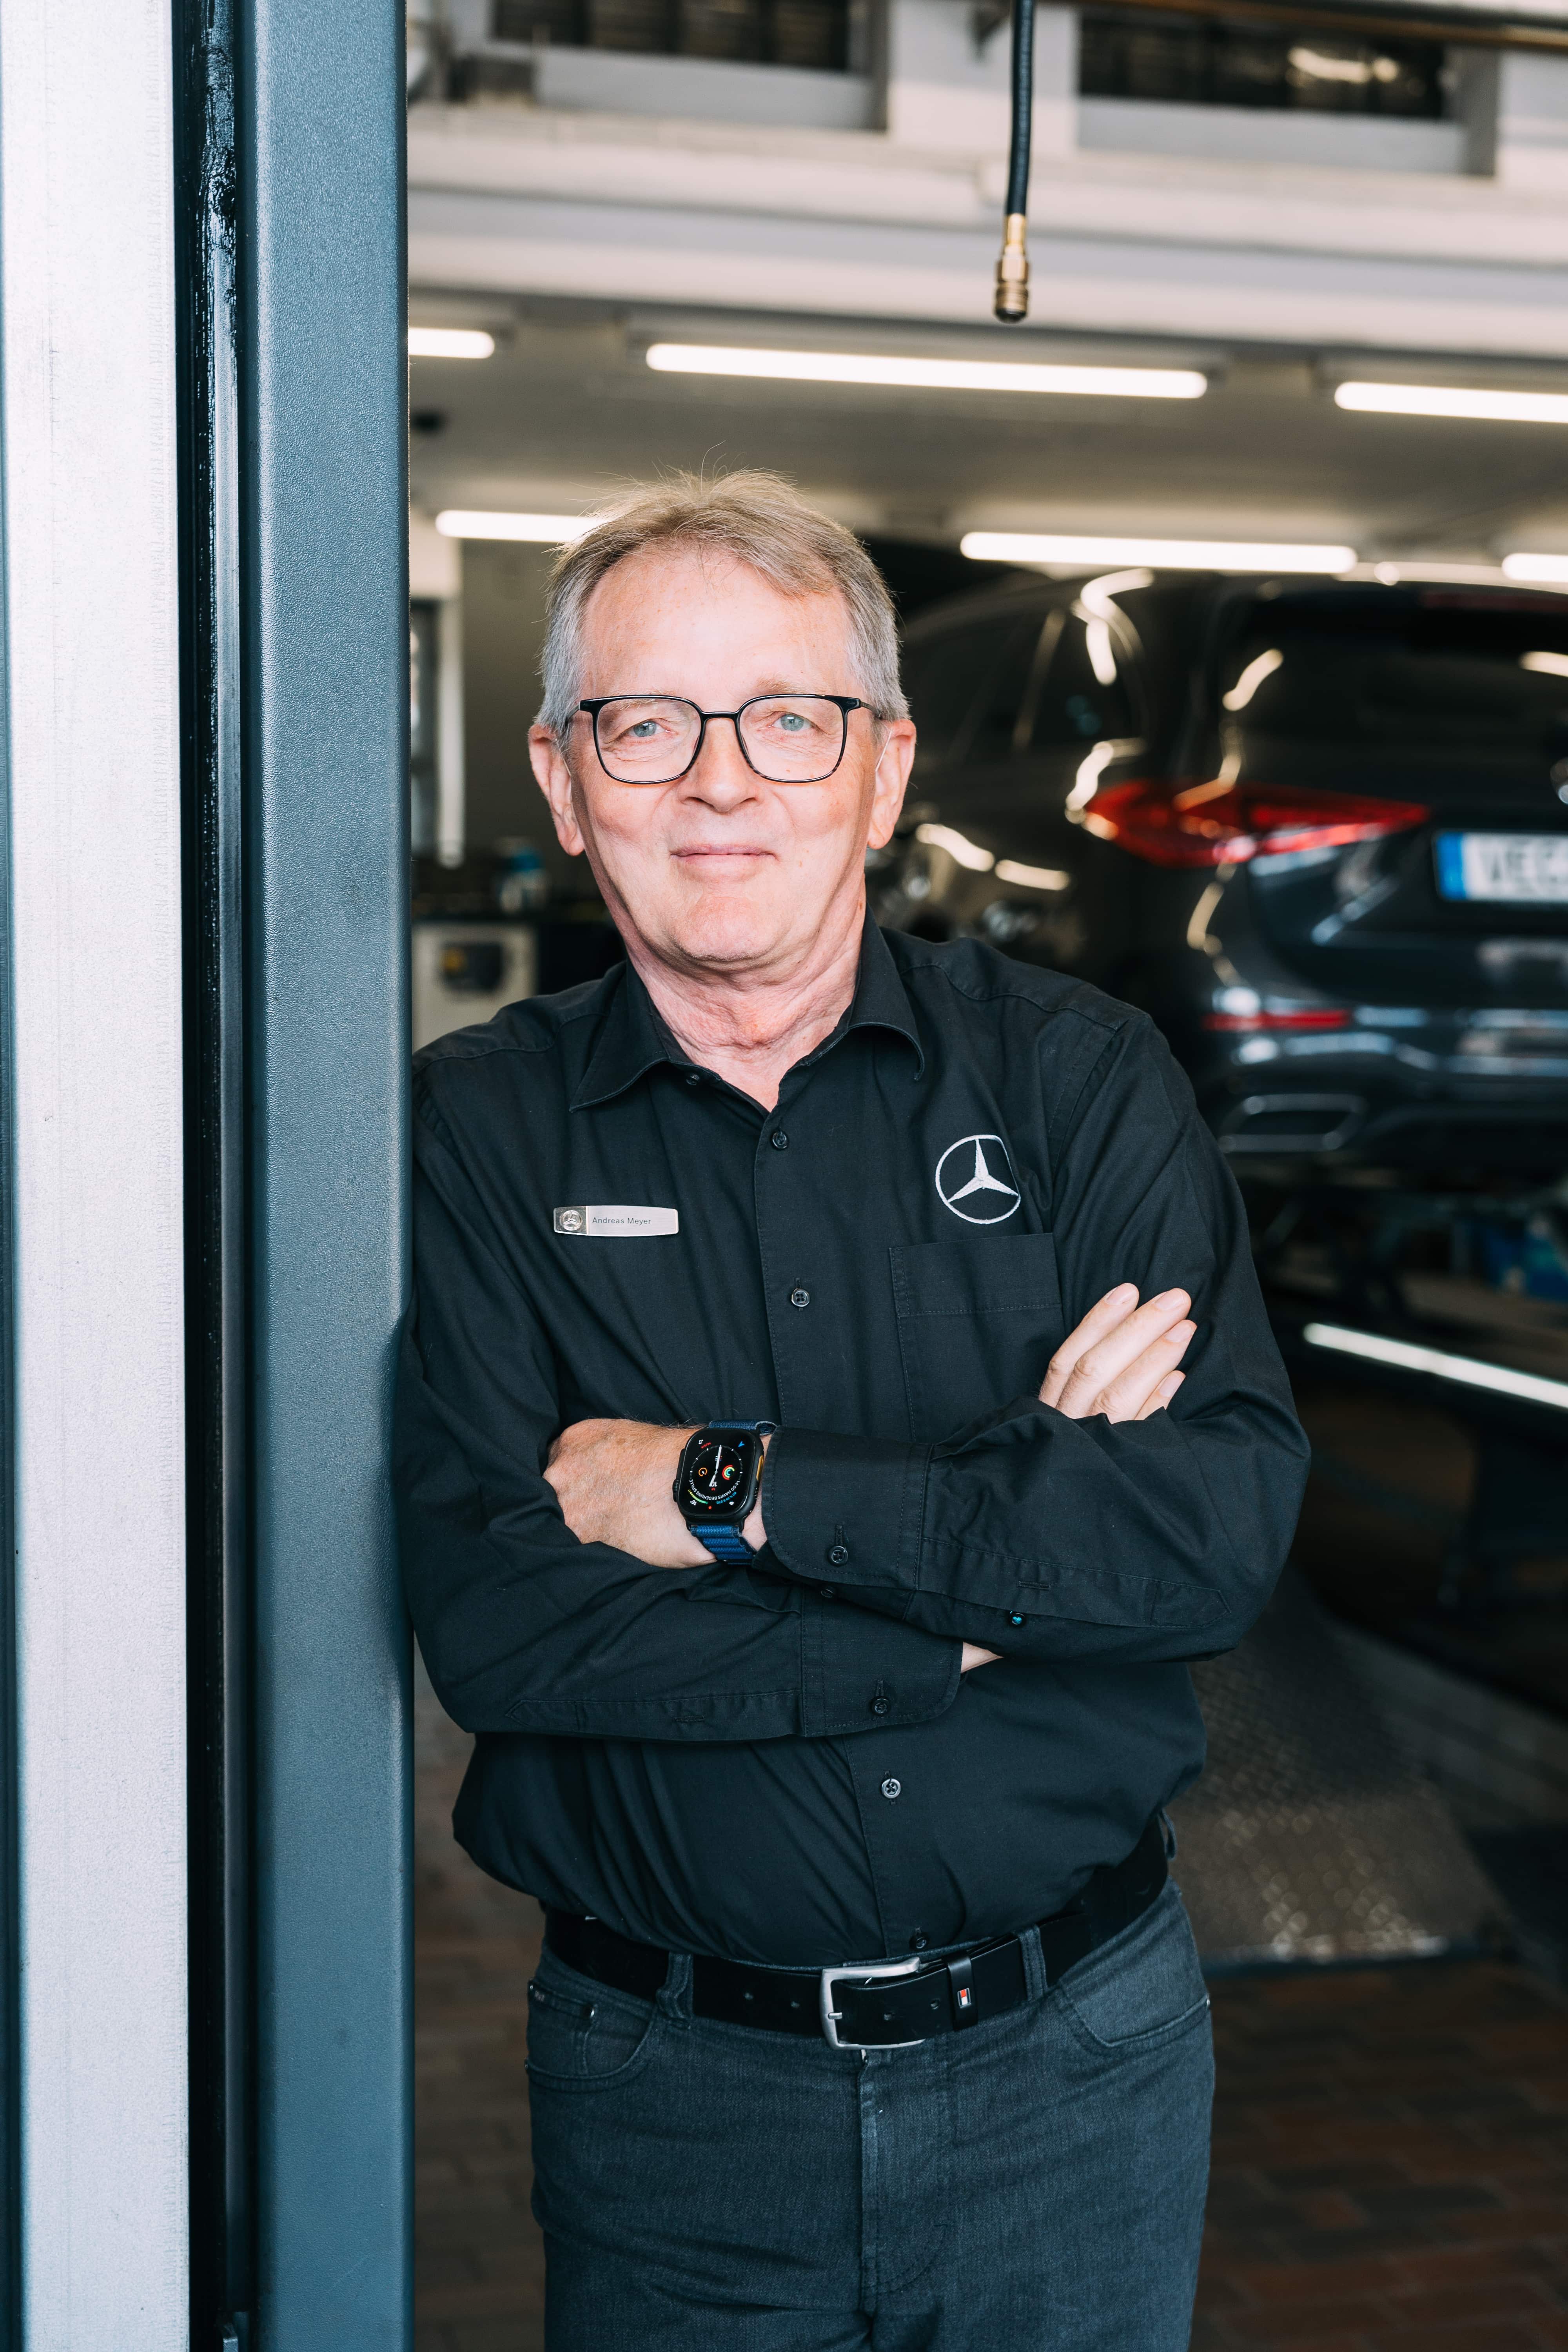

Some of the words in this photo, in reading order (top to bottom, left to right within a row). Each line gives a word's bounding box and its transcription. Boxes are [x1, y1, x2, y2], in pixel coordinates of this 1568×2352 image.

[627, 1218, 651, 1226] Meyer
[689, 1479, 697, 1492] SPILLE
[731, 1480, 740, 1491] 14:00
[696, 1491, 717, 1500] BEGEHUNG
[718, 1490, 731, 1499] HAWIS
